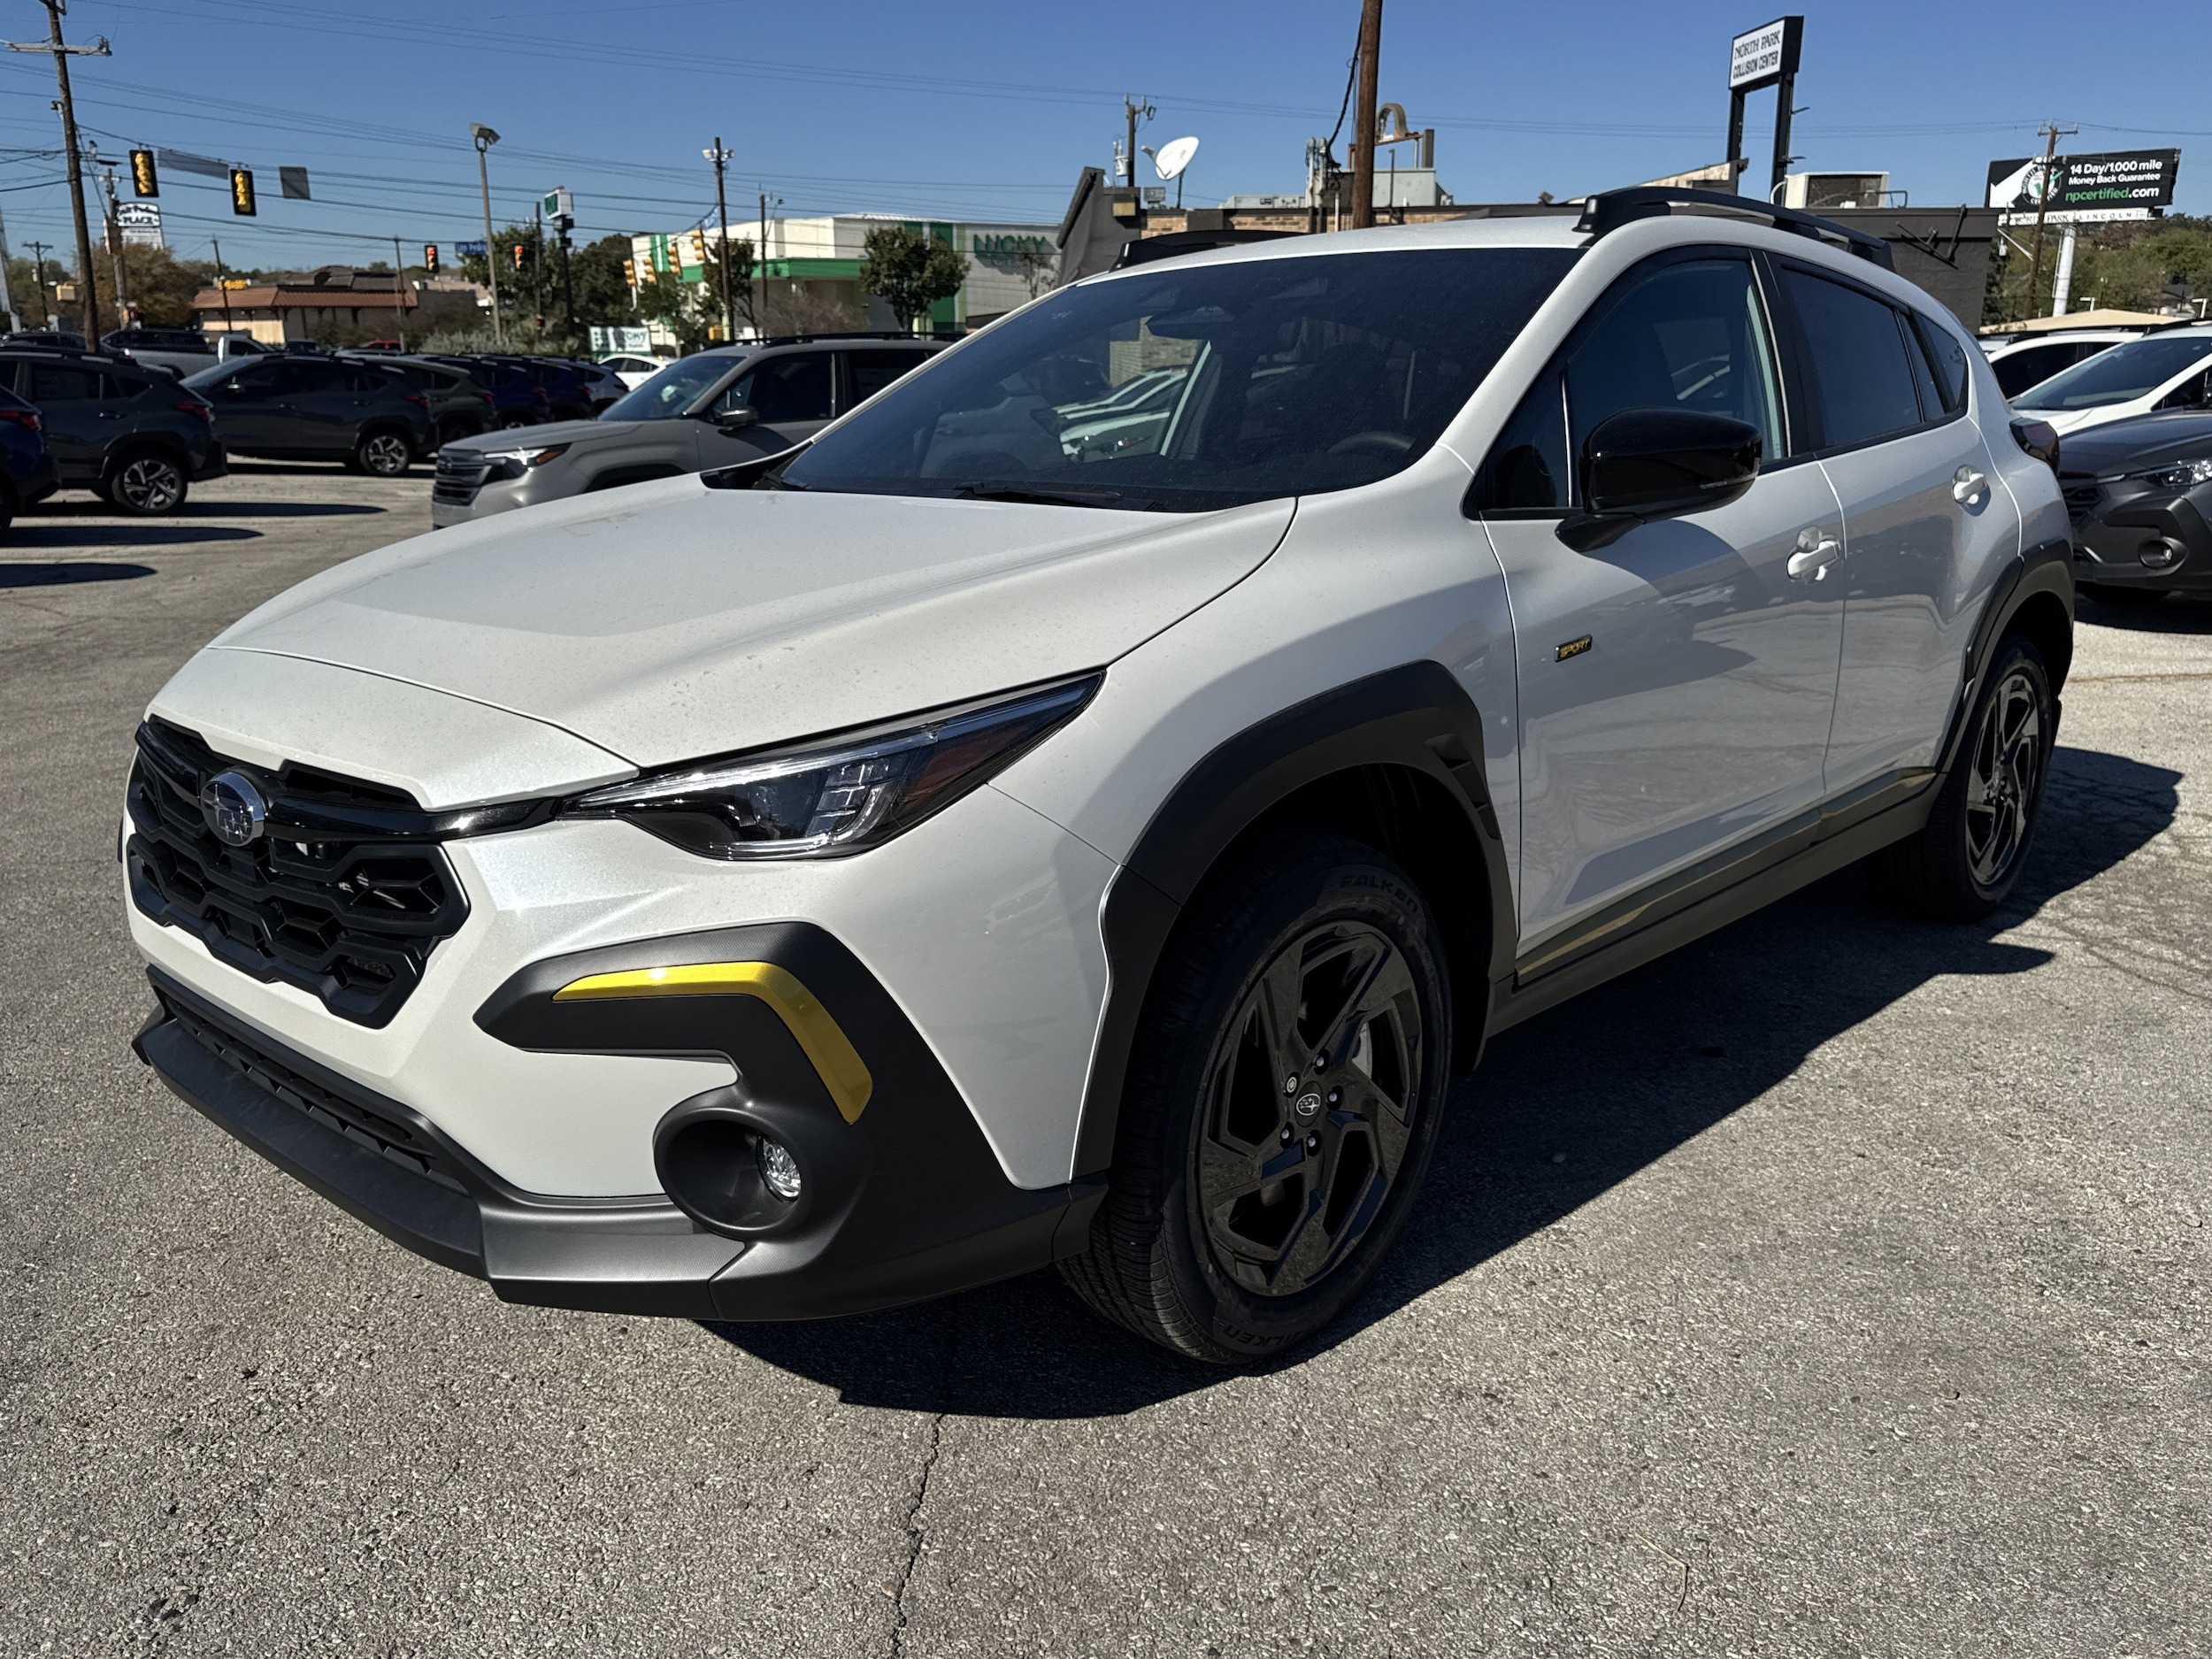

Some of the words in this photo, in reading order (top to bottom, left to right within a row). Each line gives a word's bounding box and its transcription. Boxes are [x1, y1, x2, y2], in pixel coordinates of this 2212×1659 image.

[1734, 39, 1760, 60] NORTH
[1761, 30, 1780, 50] PARK
[1733, 58, 1758, 80] COLLISION
[1758, 50, 1778, 71] CENTER
[2070, 164, 2083, 175] 14
[2084, 160, 2138, 175] Day/1,000
[2139, 159, 2163, 171] mile
[2069, 176, 2096, 186] Money
[2096, 175, 2116, 184] Back
[2117, 173, 2162, 182] Guarantee
[2065, 187, 2160, 204] npcertified.com
[2047, 214, 2070, 223] PARK
[2079, 211, 2131, 220] LINCOLN
[974, 234, 1046, 255] LUCKY
[1560, 638, 1590, 657] SPORT
[1222, 1324, 1308, 1348] ALKEN
